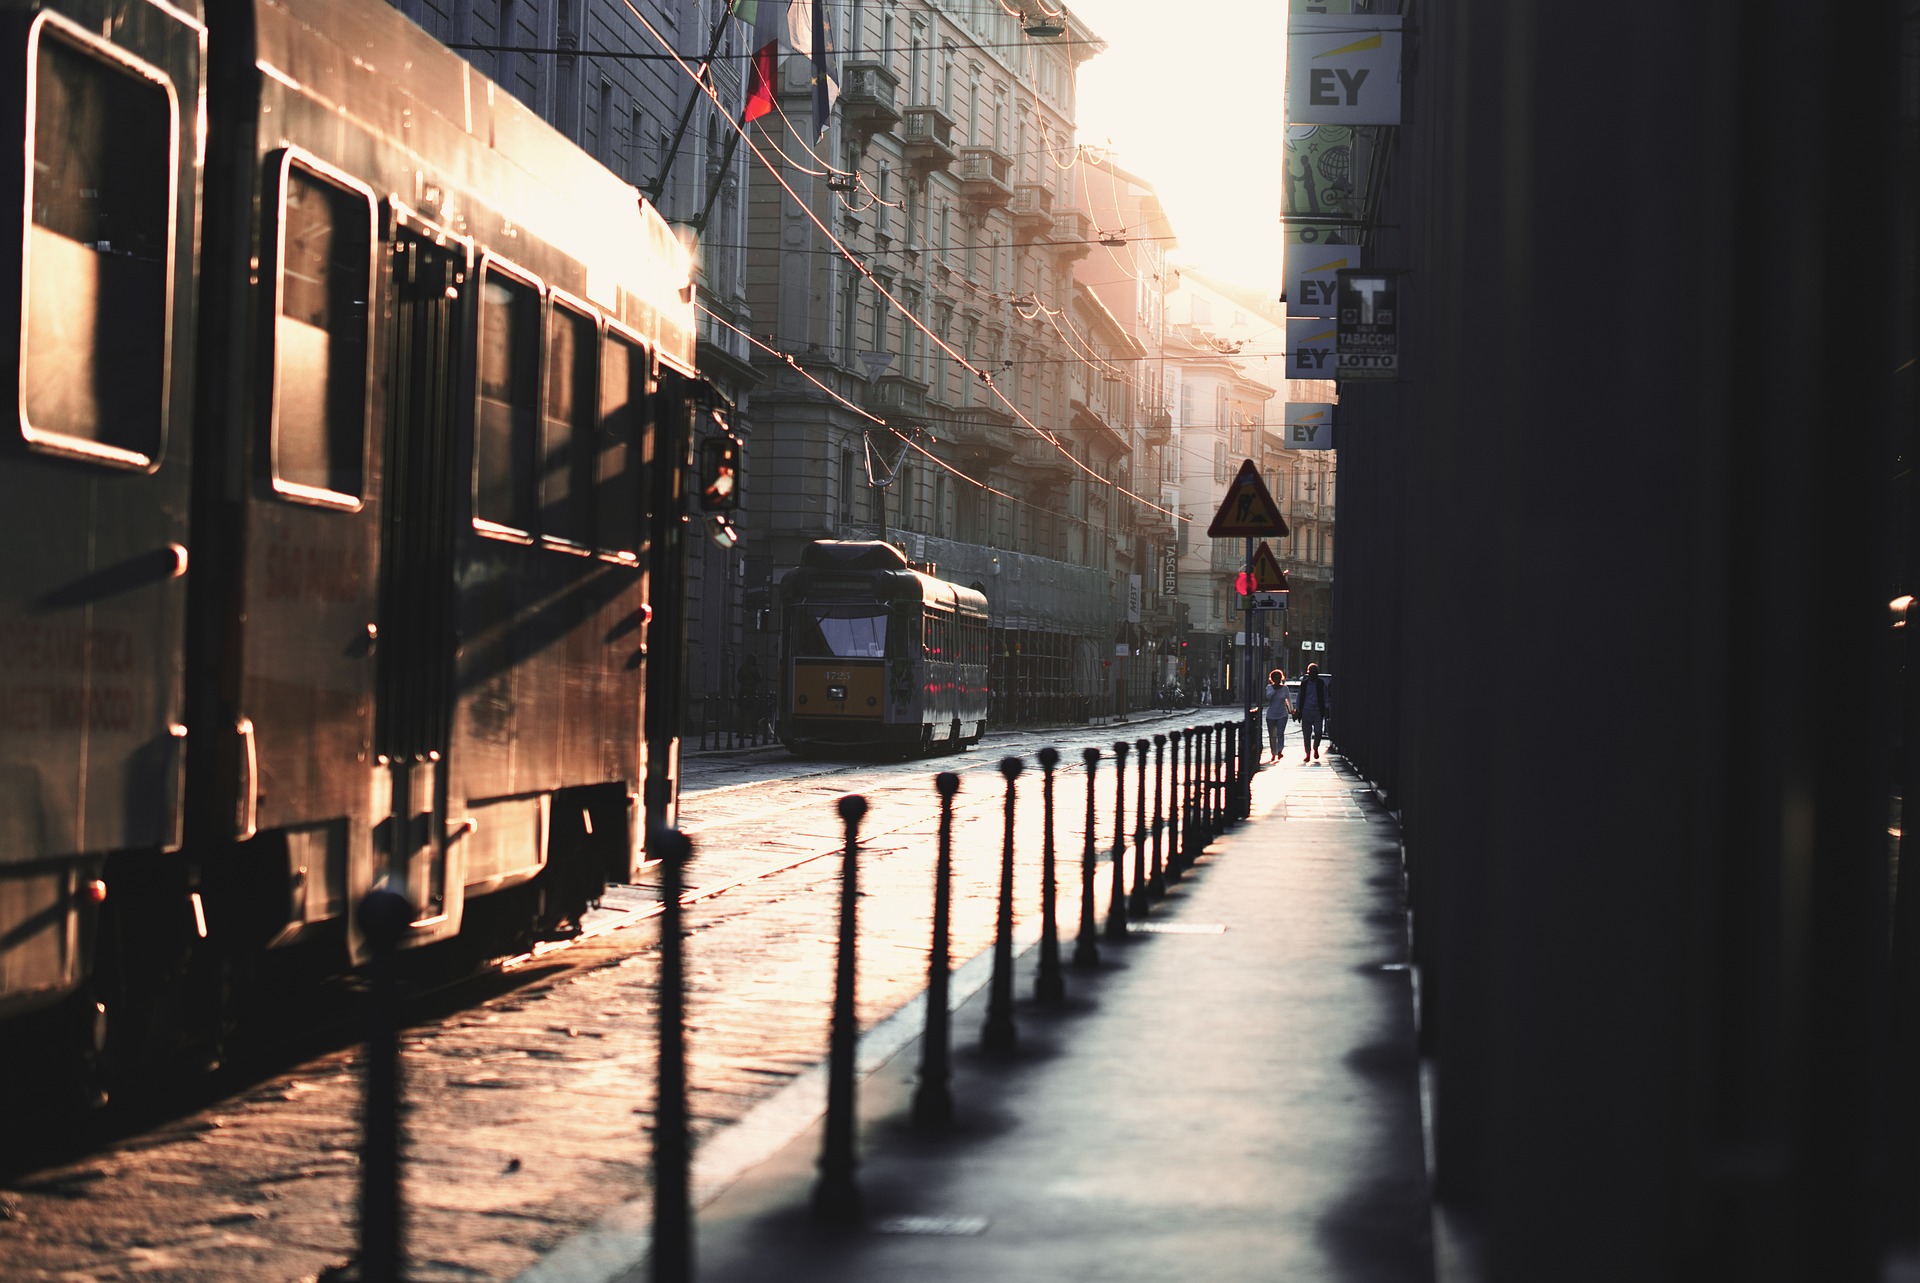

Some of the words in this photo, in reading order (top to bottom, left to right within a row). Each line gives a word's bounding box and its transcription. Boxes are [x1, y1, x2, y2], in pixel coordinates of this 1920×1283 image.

[1310, 69, 1370, 106] EY
[1300, 280, 1337, 305] EY
[1349, 279, 1386, 325] T
[1339, 333, 1395, 345] TABACCHI
[1296, 348, 1329, 369] EY
[1339, 355, 1393, 367] LOTTO
[1293, 425, 1318, 441] EY
[1166, 544, 1176, 594] TASCHEN
[1130, 583, 1138, 614] MBT
